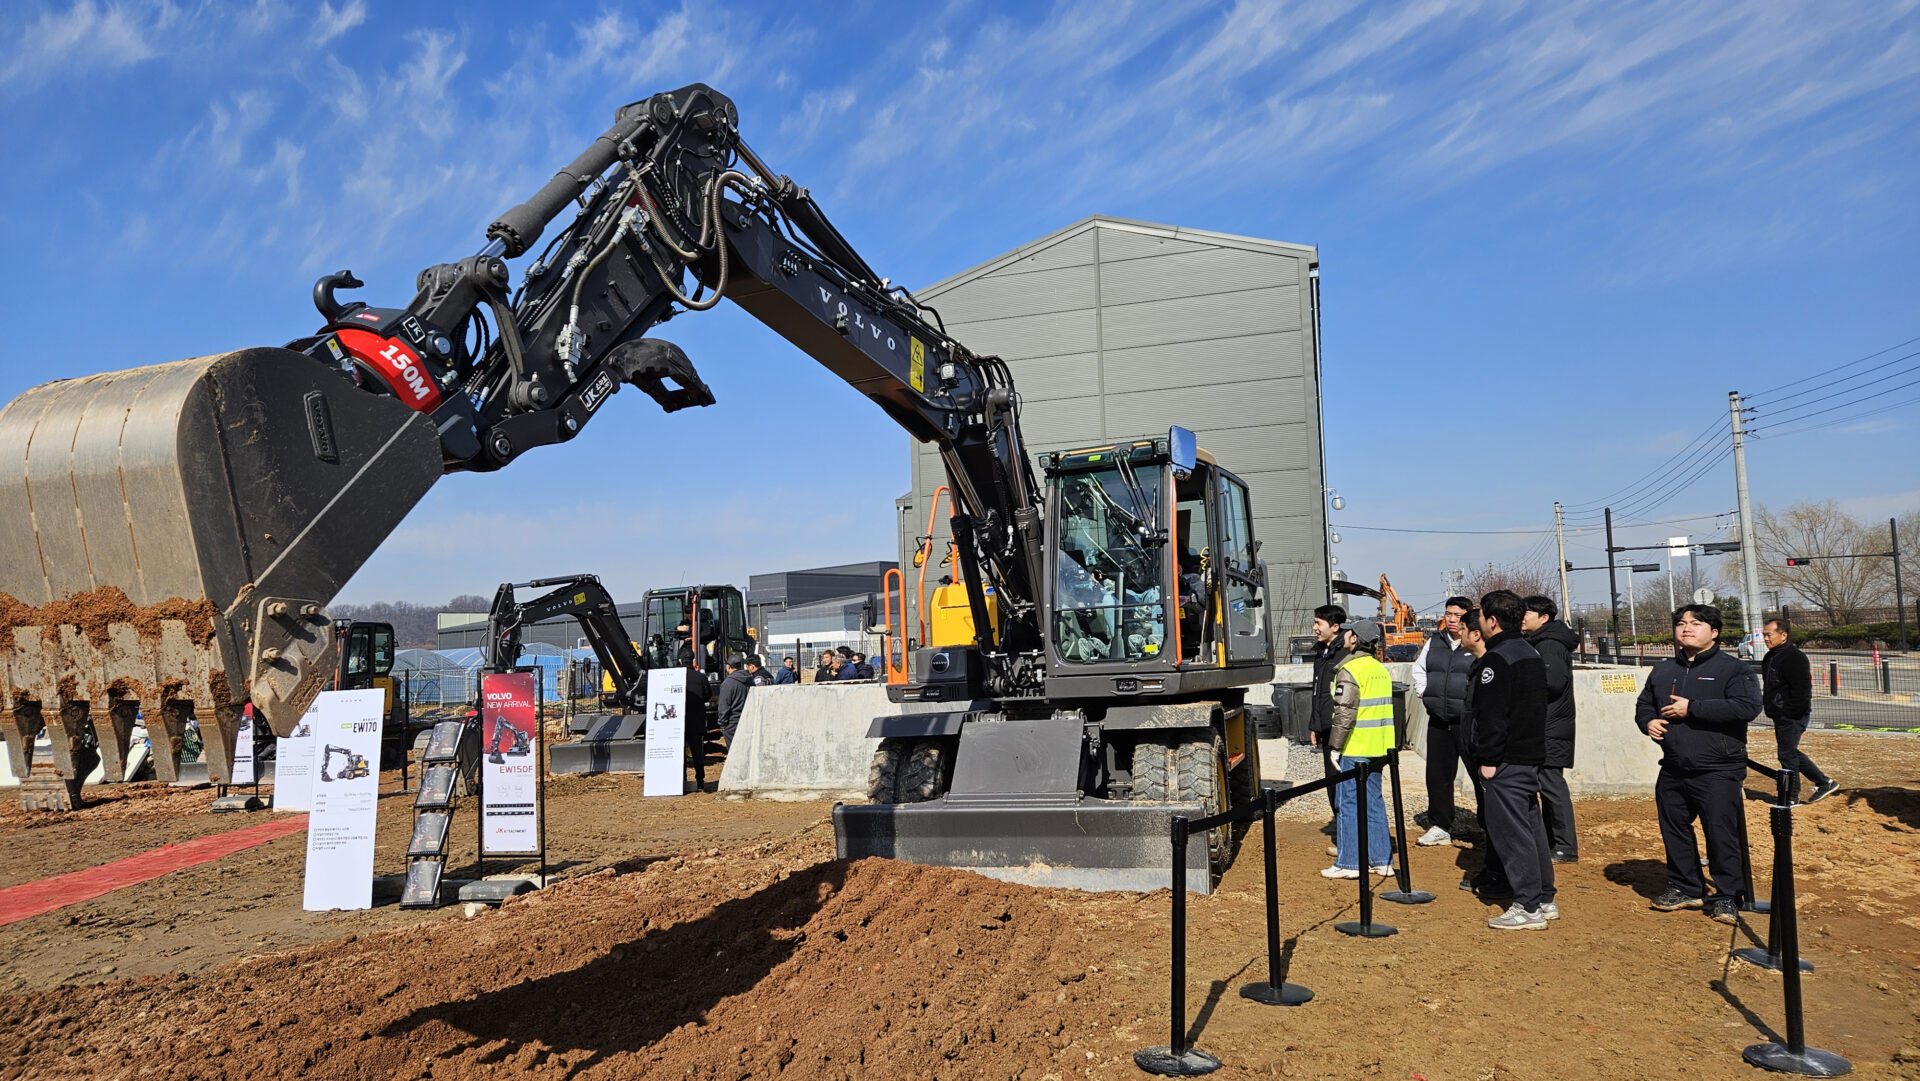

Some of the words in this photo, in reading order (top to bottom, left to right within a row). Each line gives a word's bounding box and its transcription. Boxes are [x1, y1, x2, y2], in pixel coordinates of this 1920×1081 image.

[819, 286, 896, 350] VOLVO
[408, 320, 423, 337] JK
[379, 344, 431, 401] 150M
[585, 388, 600, 407] JK
[312, 400, 330, 453] VOLVO
[545, 599, 573, 612] VOLVO
[486, 692, 512, 700] VOLVO
[486, 701, 502, 709] NEW
[503, 700, 532, 709] ARRIVAL
[352, 721, 377, 733] EW170
[499, 765, 533, 774] EW150F
